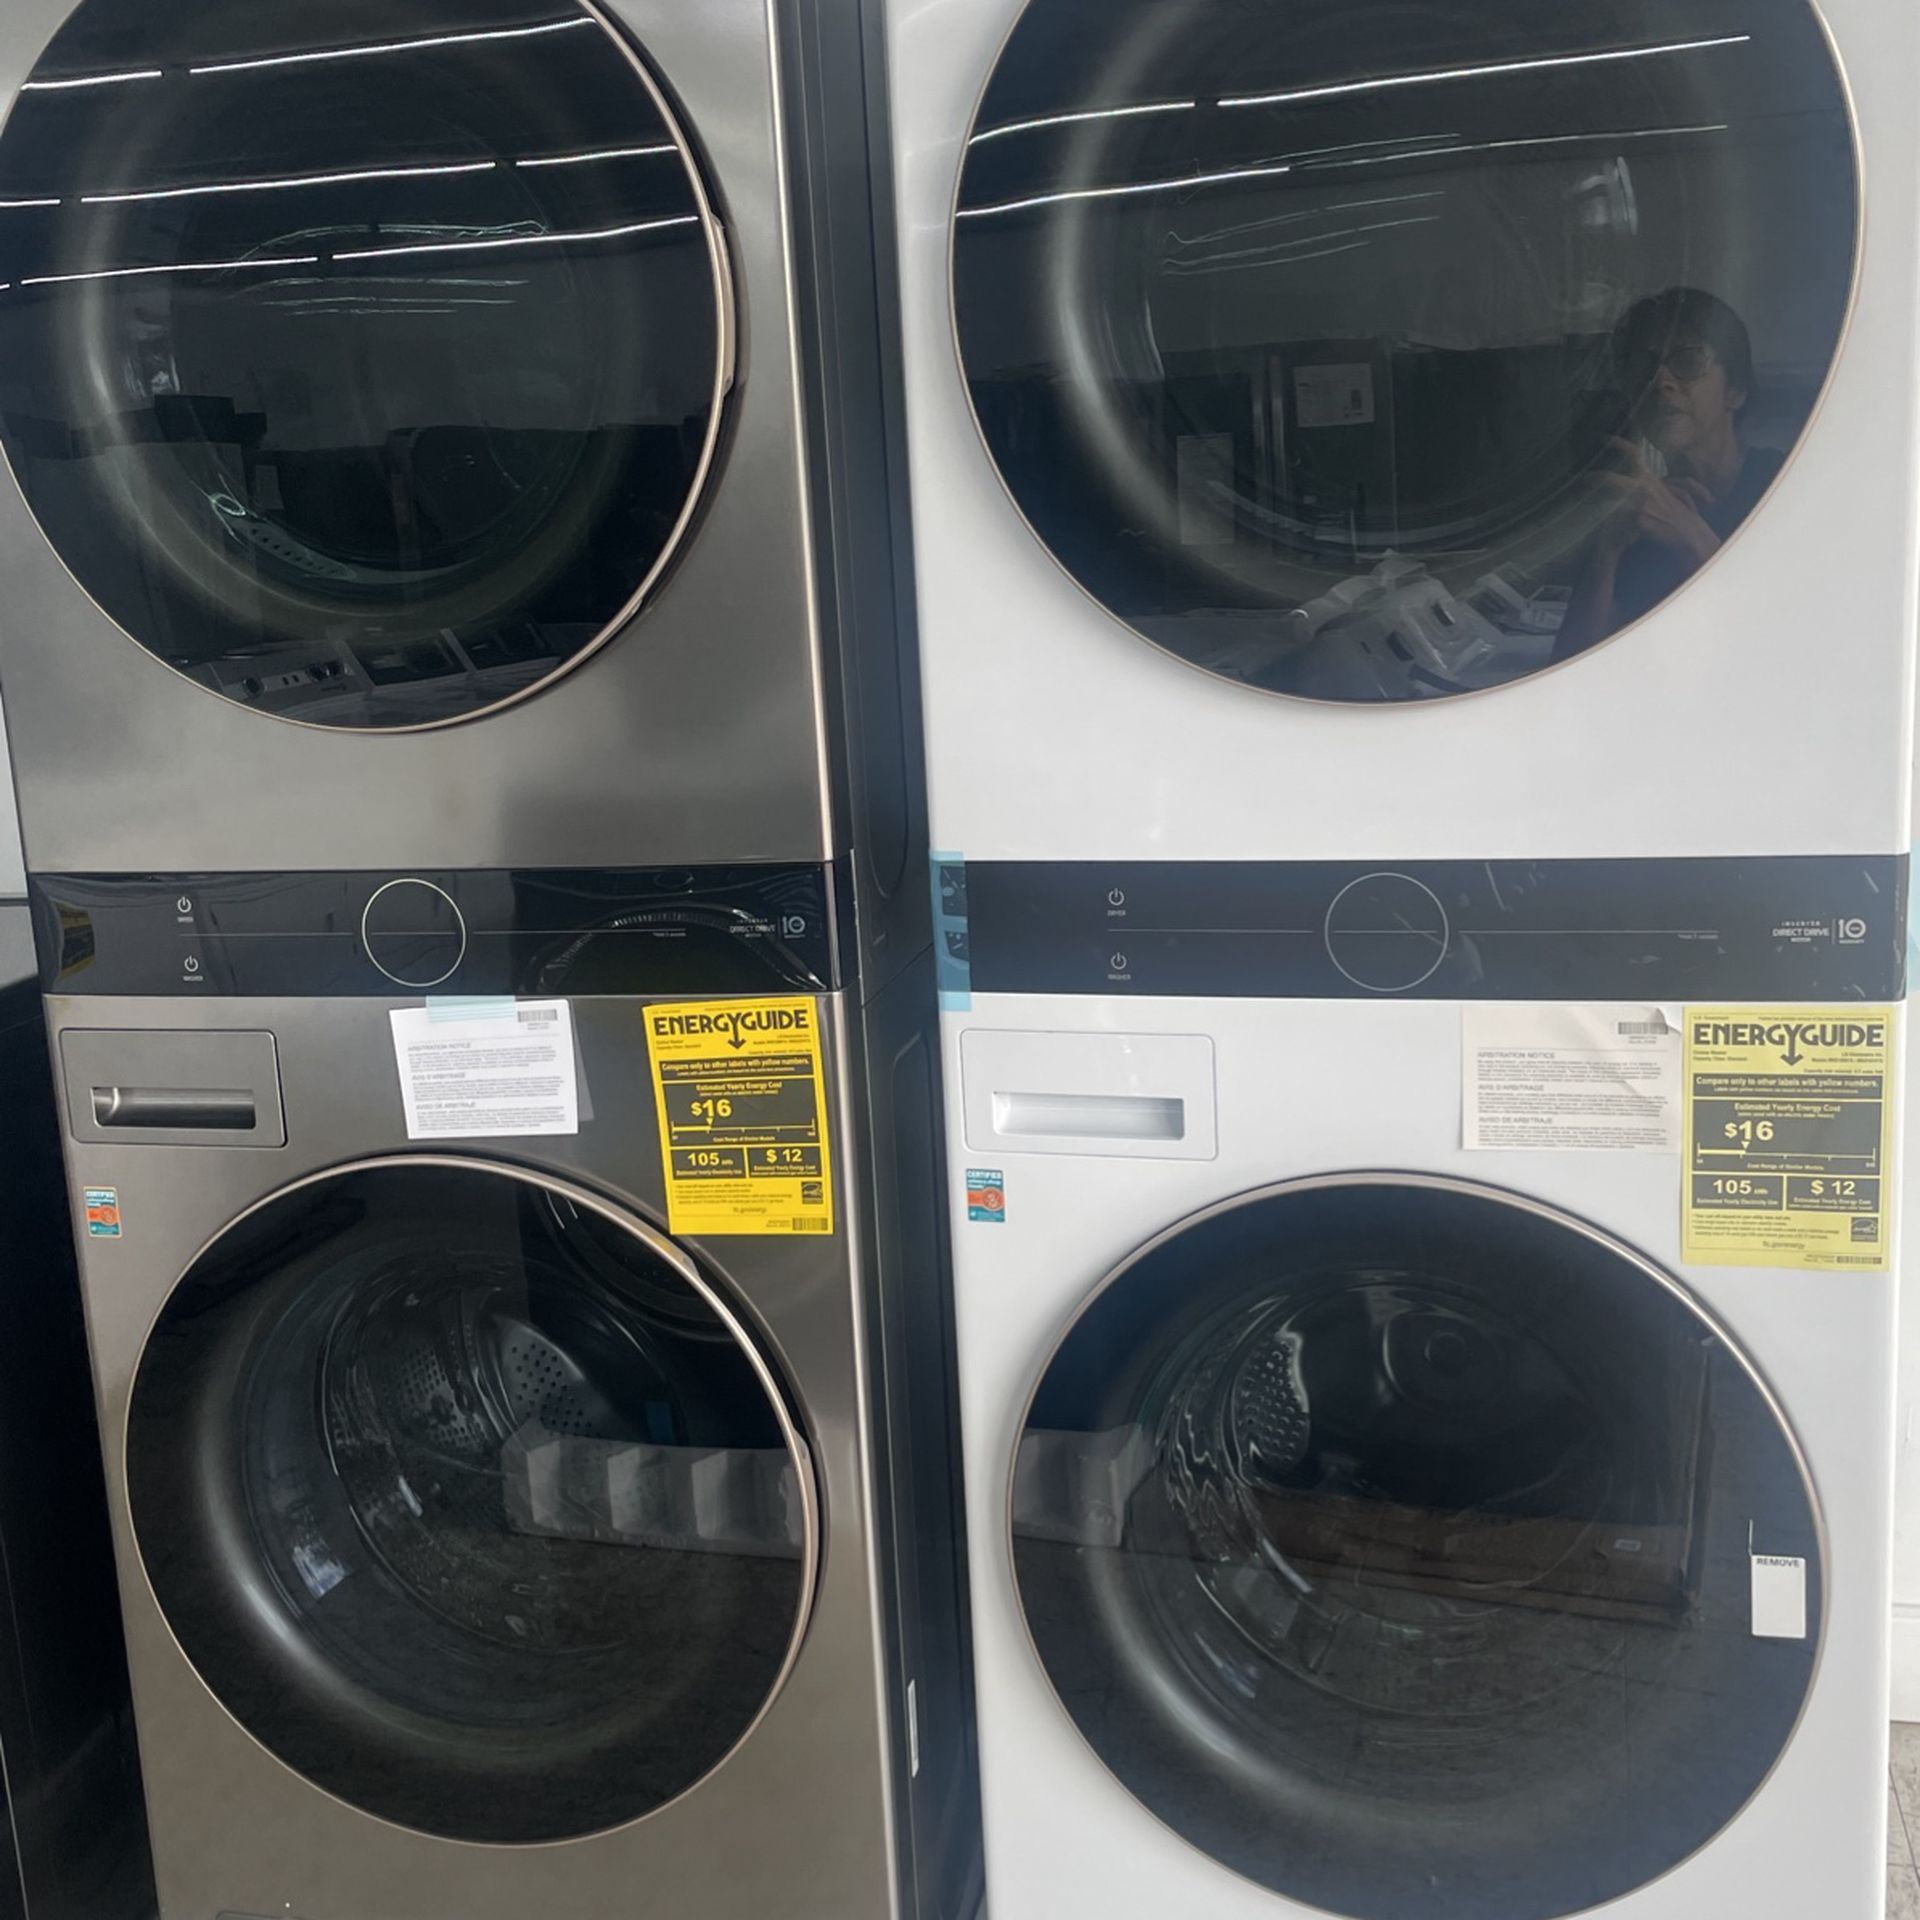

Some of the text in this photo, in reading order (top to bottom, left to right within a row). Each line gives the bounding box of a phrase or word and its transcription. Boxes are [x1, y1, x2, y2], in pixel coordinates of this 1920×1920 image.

[1772, 928, 1829, 937] DIRECT DRIVE
[653, 1009, 809, 1039] ENERGYGUIDE
[1694, 1024, 1884, 1052] ENERGYGUIDE
[1696, 1076, 1729, 1086] Compare
[1730, 1077, 1746, 1087] only
[1747, 1077, 1756, 1085] to
[1757, 1078, 1777, 1086] other
[1777, 1078, 1800, 1086] labels
[1801, 1078, 1817, 1087] with
[1818, 1078, 1842, 1088] yellow
[690, 1098, 732, 1117] $16
[1734, 1102, 1841, 1113] Estimated Yearly Energy Cost
[1724, 1120, 1774, 1141] $16
[688, 1152, 719, 1166] 105
[766, 1148, 802, 1163] $ 12
[1713, 1179, 1752, 1194] 105
[1810, 1179, 1855, 1196] $ 12
[1756, 1557, 1800, 1568] REMOVE
